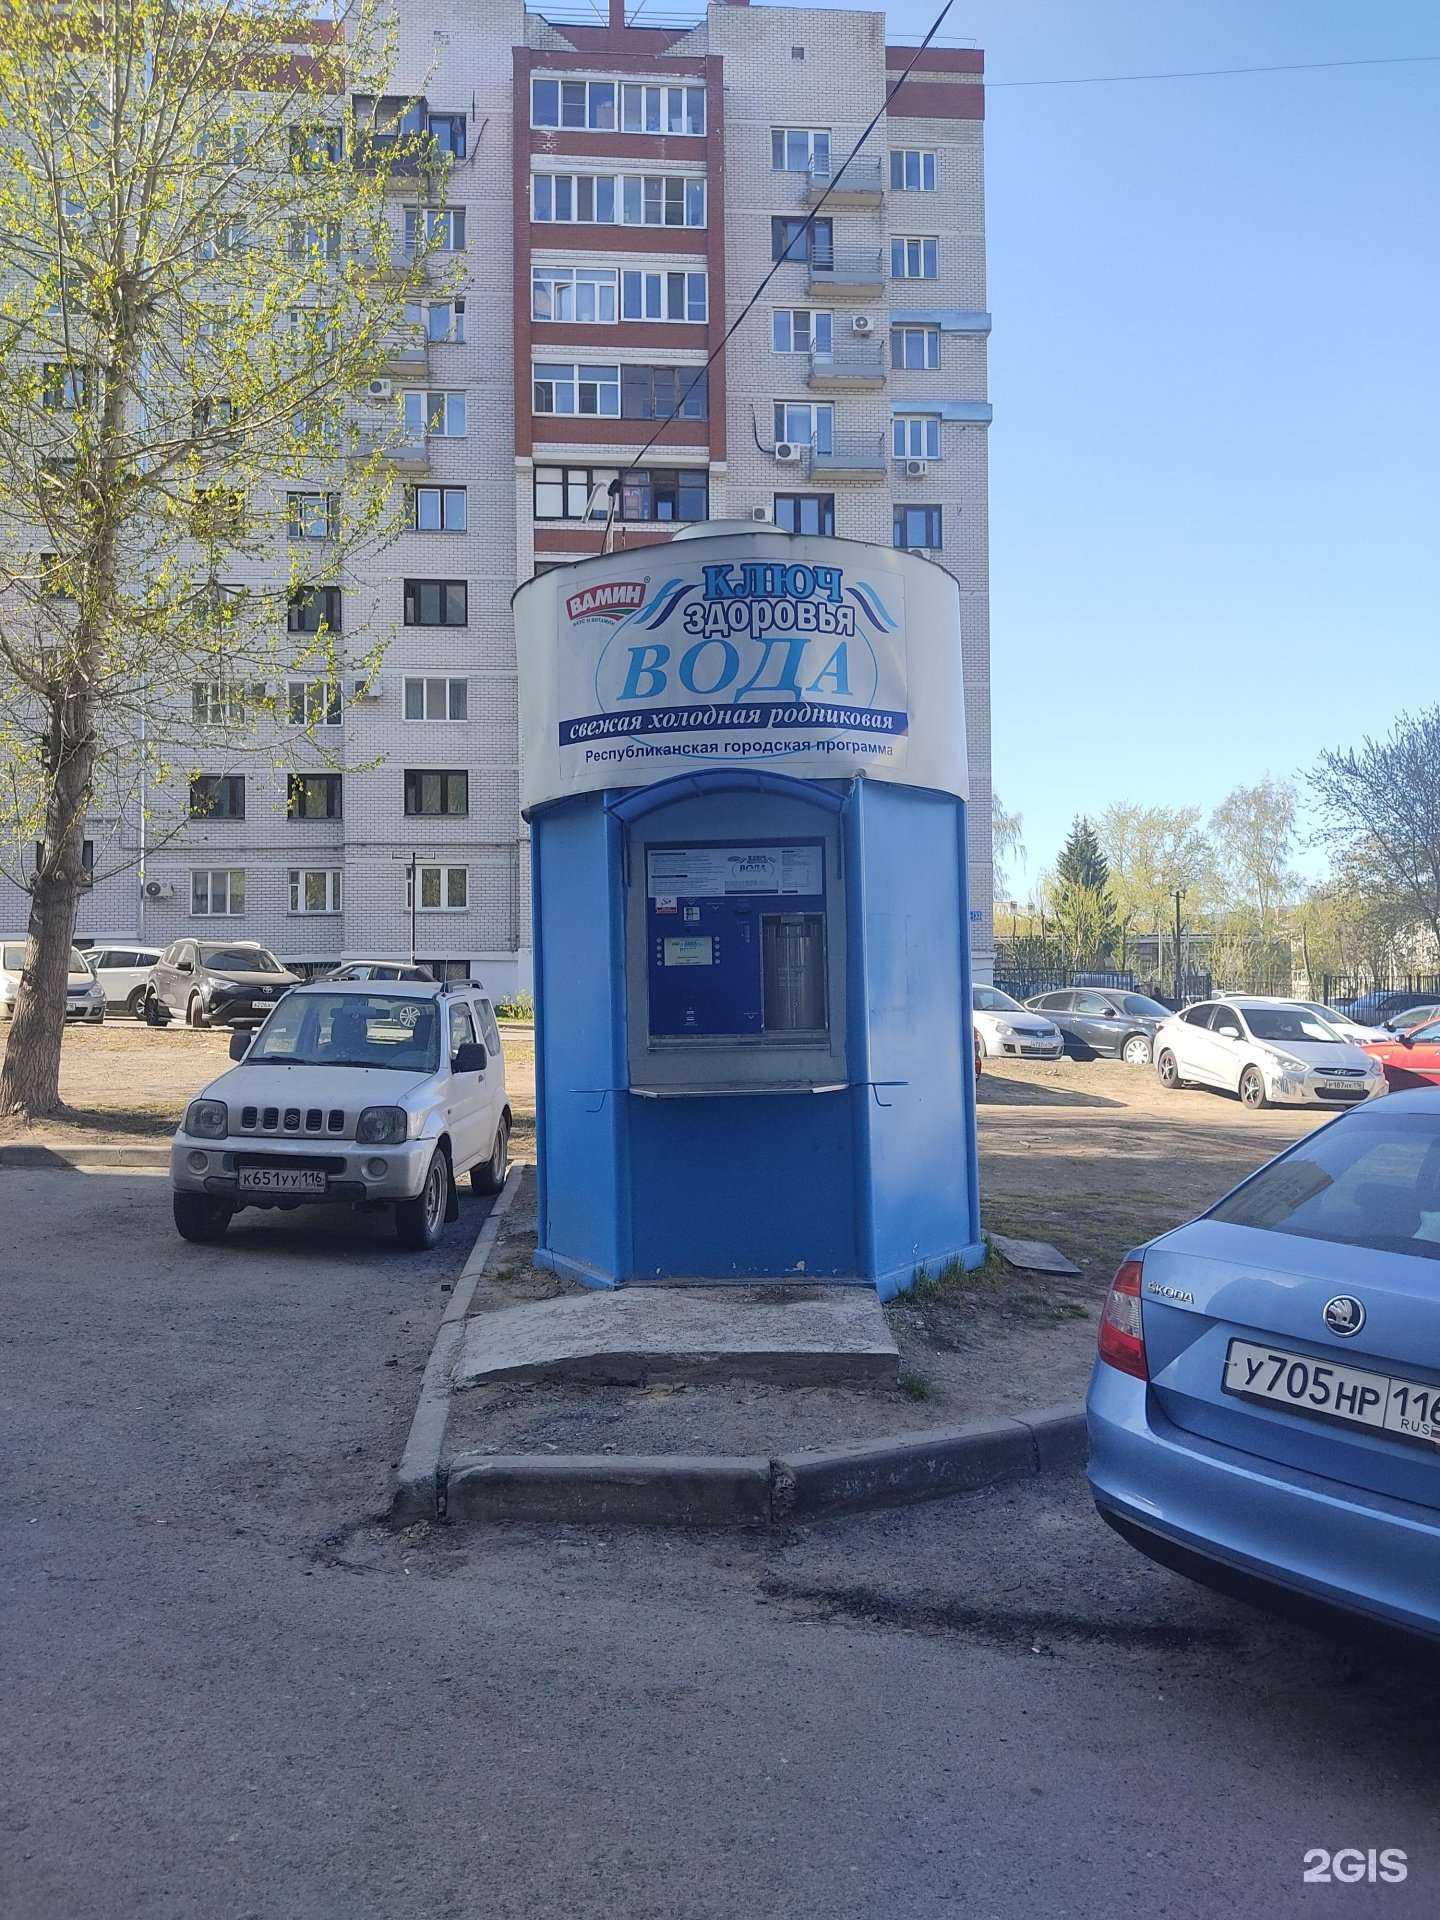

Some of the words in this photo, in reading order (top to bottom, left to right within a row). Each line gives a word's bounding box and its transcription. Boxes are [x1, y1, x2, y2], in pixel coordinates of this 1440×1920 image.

[569, 585, 642, 617] ВАМИН
[702, 563, 843, 603] КЛЮЧ
[683, 599, 855, 639] ЗДОРОВЬЯ
[616, 637, 853, 704] ВОДА
[569, 714, 642, 739] свежая
[647, 704, 761, 729] холодная
[766, 702, 894, 730] родниковая
[585, 741, 719, 763] Республиканская
[724, 740, 810, 756] городская
[816, 740, 893, 756] программа
[1400, 1418, 1431, 1436] RUS
